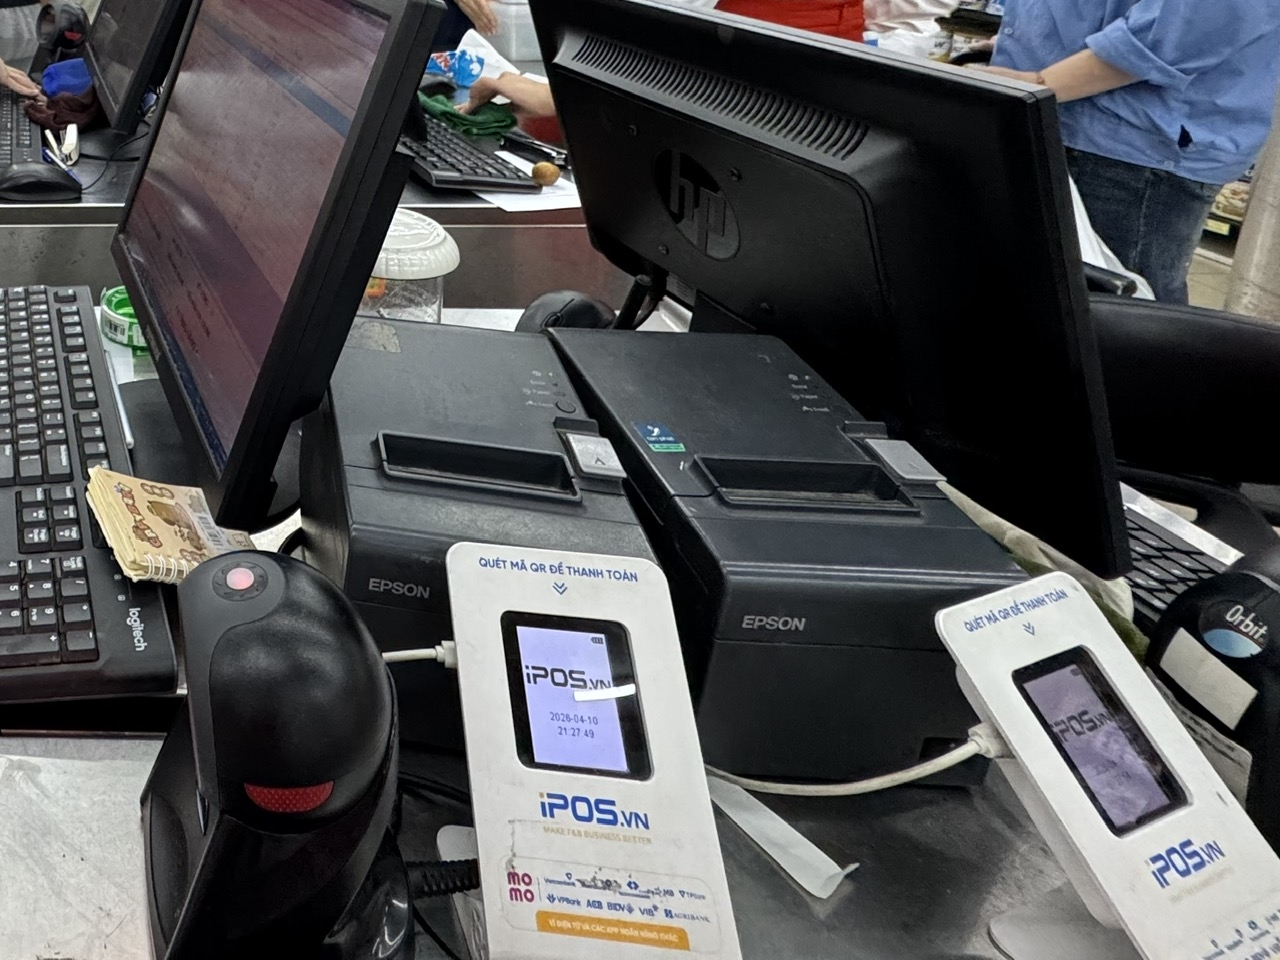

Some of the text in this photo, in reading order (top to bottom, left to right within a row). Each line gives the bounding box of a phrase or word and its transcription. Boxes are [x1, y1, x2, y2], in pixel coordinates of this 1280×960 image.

[479, 557, 507, 570] QUÉT
[510, 559, 528, 571] MÃ
[530, 562, 547, 574] QR
[566, 566, 604, 579] THANH
[606, 569, 638, 582] TOÁN
[368, 577, 430, 598] EPSON
[998, 608, 1012, 620] QR
[1020, 596, 1048, 612] THANH
[1044, 588, 1068, 603] TOÁN
[126, 607, 147, 651] logitech
[742, 614, 806, 631] EPSON
[1225, 604, 1267, 640] Orbit
[538, 792, 650, 830] iPOS.VN
[1144, 838, 1226, 889] iPOS.VN
